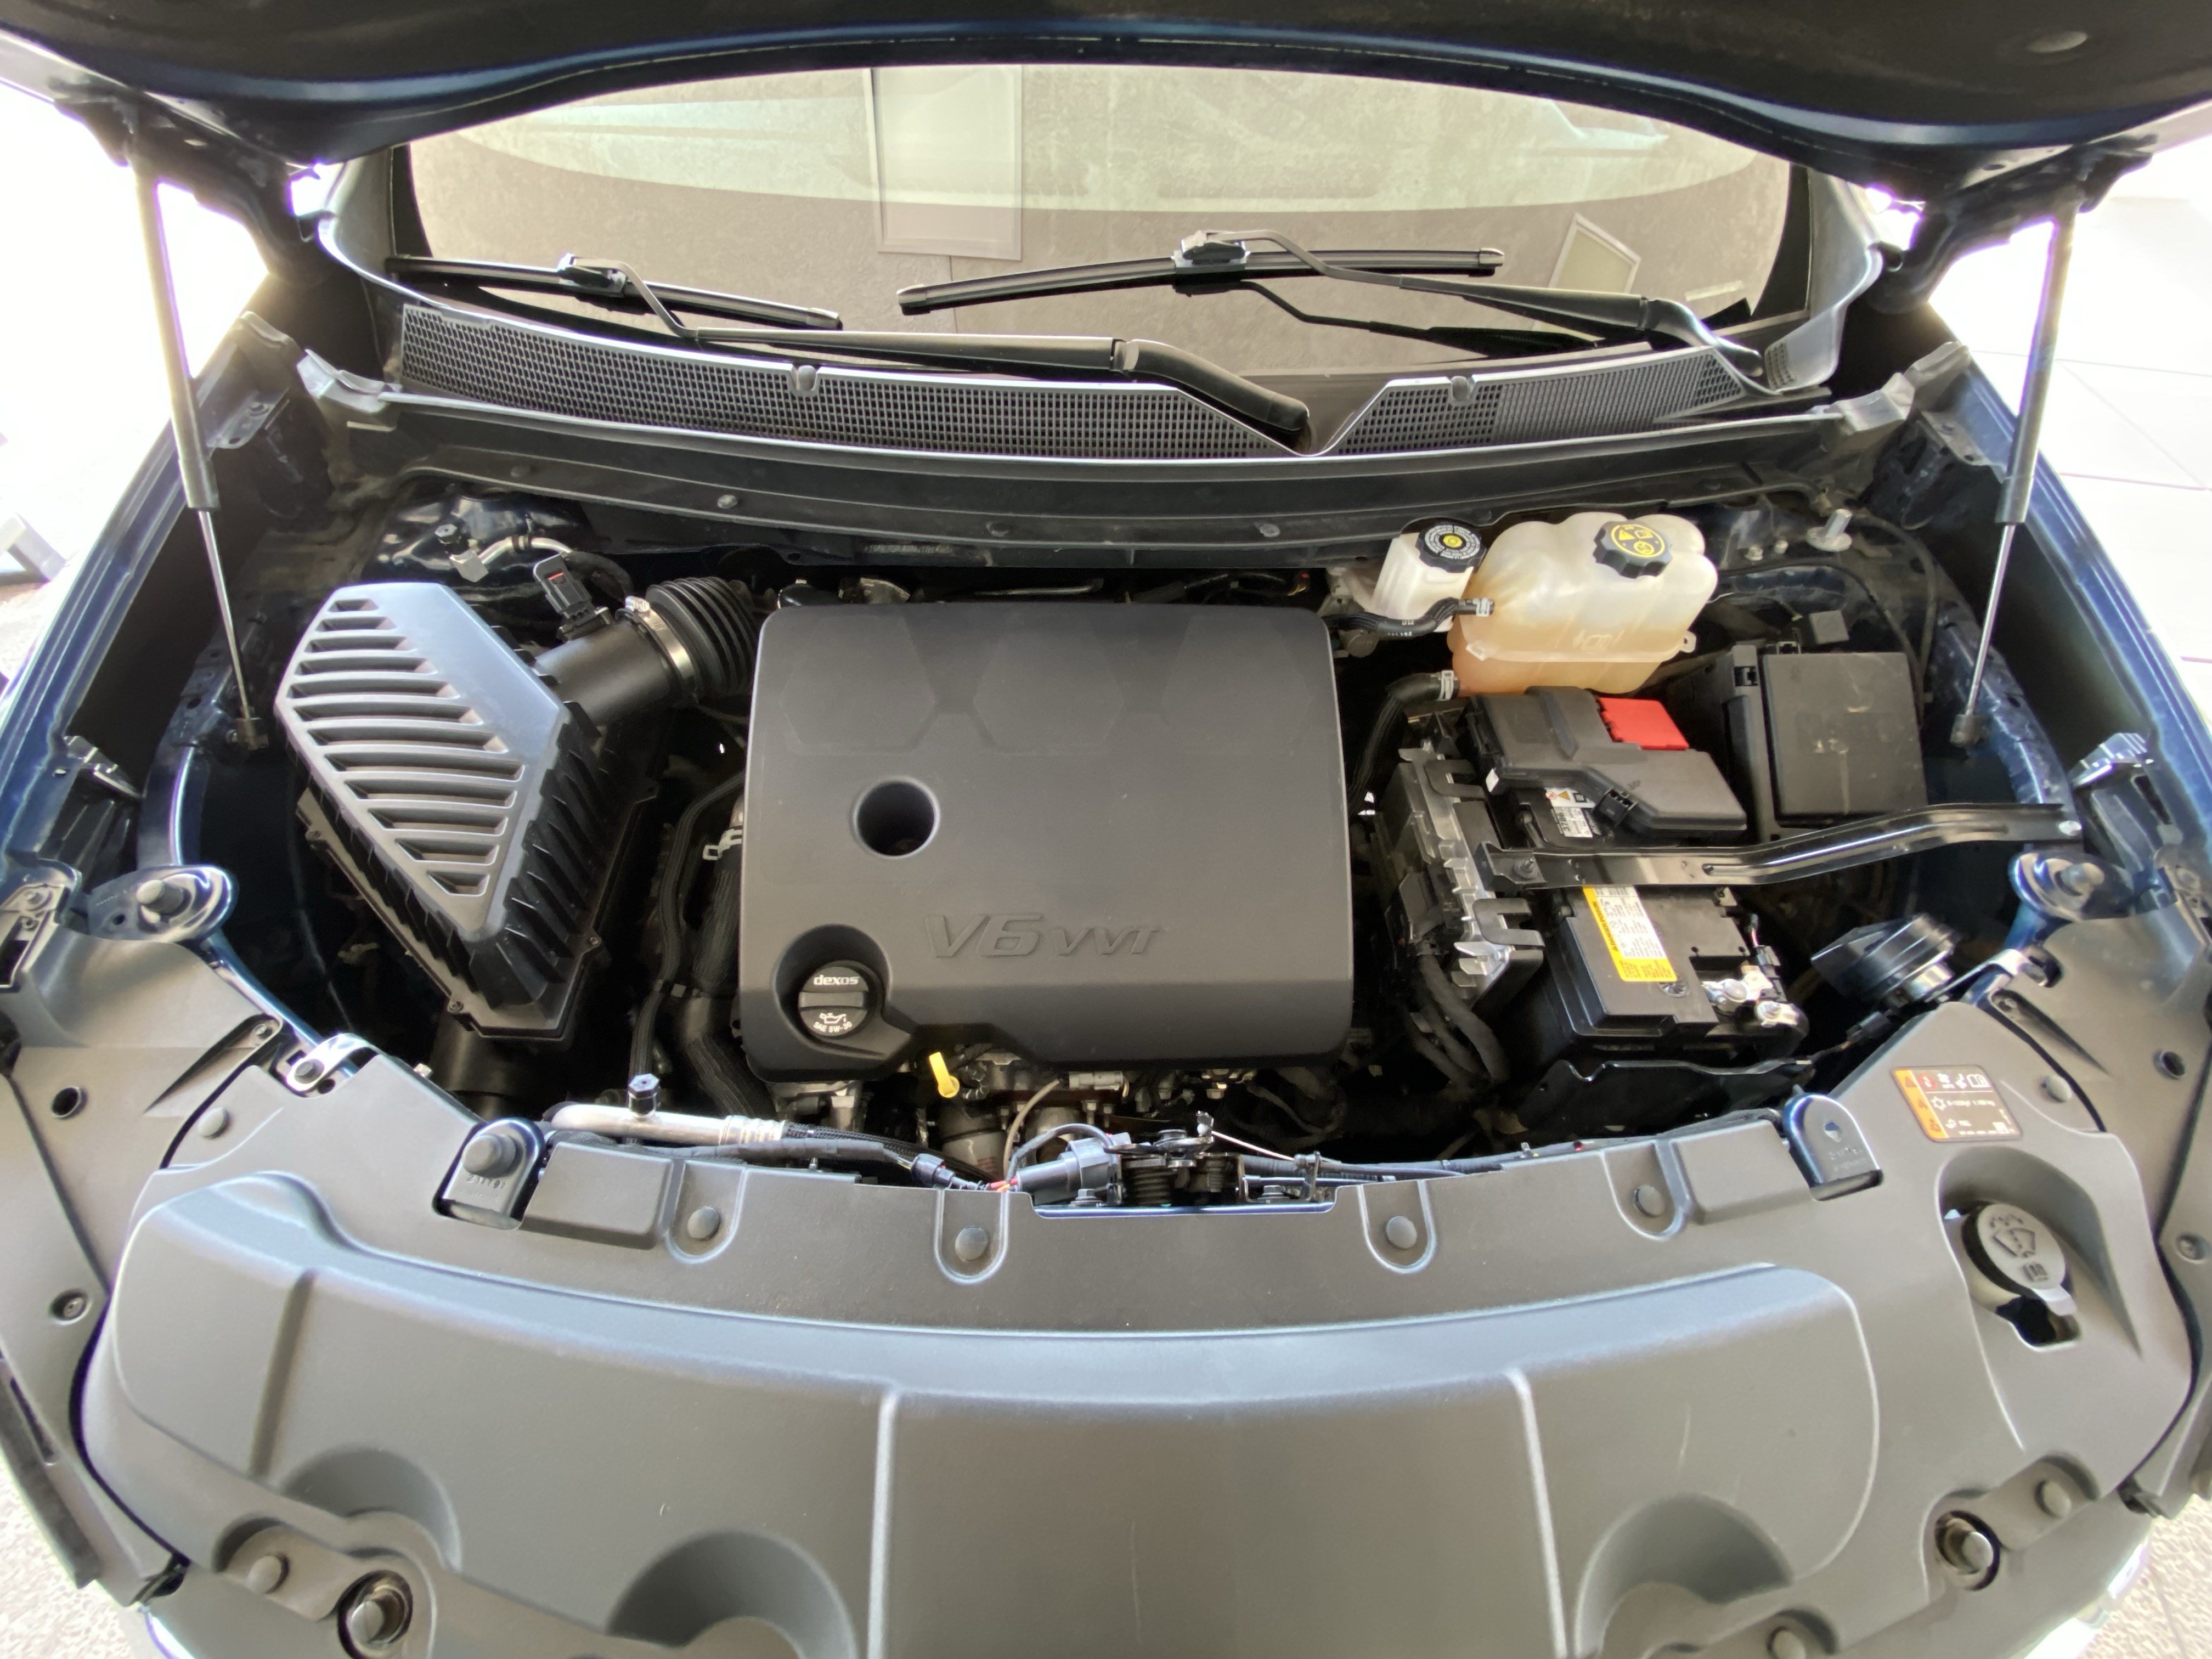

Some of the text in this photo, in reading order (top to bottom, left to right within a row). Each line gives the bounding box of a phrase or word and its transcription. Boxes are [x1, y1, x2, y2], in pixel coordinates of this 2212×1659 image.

[924, 913, 1164, 958] V6 VVT
[813, 974, 861, 985] dexos
[813, 1021, 853, 1032] SAE 5W-30
